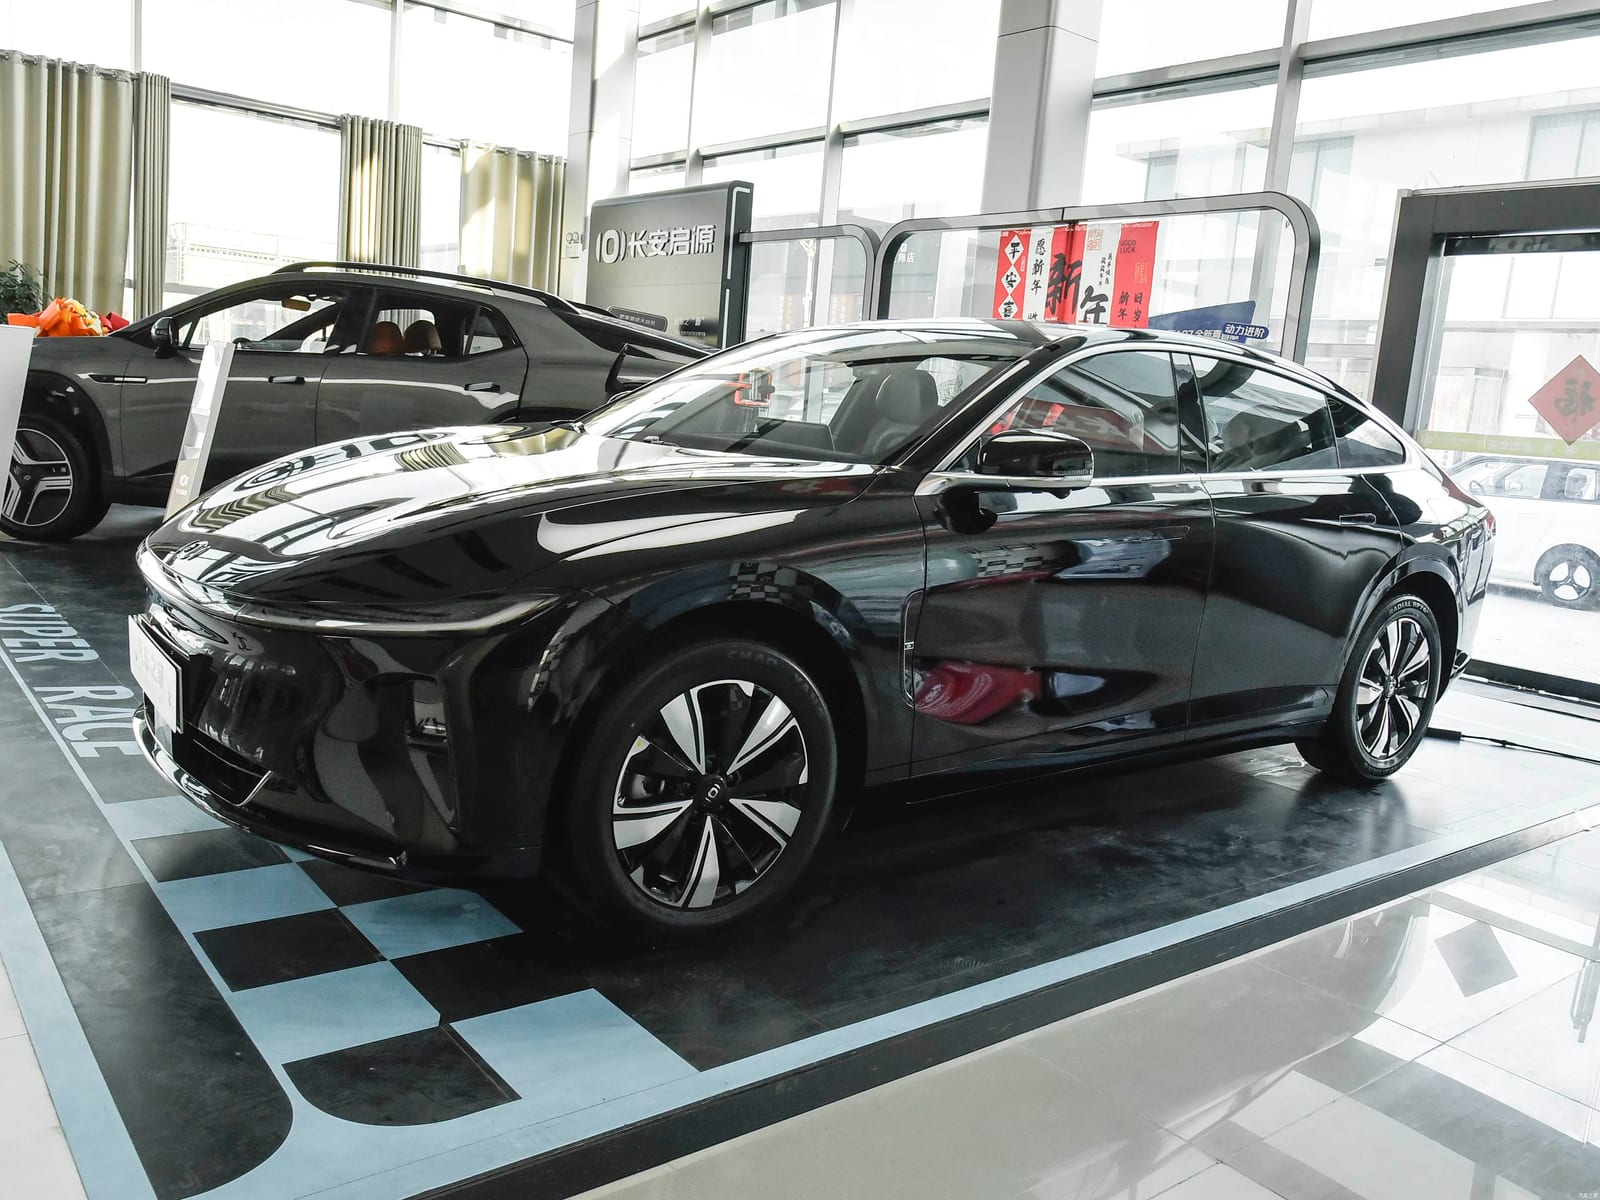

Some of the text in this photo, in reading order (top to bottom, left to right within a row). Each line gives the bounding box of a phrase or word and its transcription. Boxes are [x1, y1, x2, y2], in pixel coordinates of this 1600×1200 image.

[628, 225, 716, 258] 长安启源
[1119, 246, 1135, 254] LUCK
[1225, 323, 1265, 339] 动力进阶
[0, 603, 144, 758] SUPER RACE
